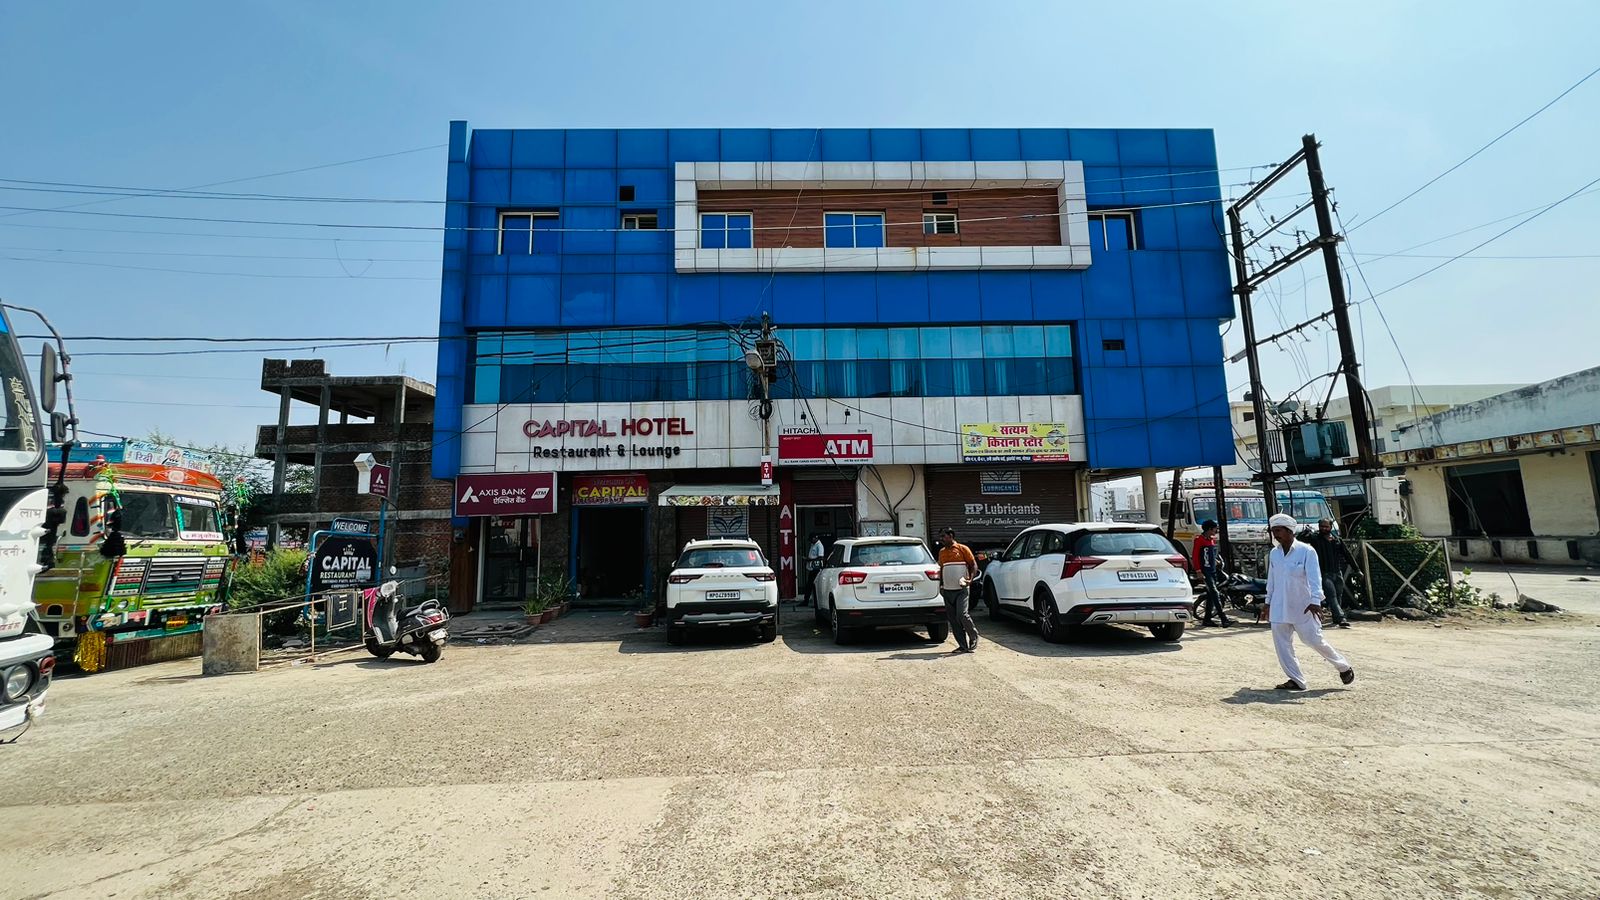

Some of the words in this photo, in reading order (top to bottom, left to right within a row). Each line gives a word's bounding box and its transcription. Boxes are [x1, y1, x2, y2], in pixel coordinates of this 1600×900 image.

[522, 419, 617, 438] CAPITAL
[621, 417, 694, 436] HOTEL
[1000, 425, 1029, 435] सत्यम
[824, 439, 869, 455] ATM
[987, 436, 1020, 447] किराना
[1022, 435, 1044, 447] स्टोर
[533, 446, 611, 458] Restaurant
[617, 444, 626, 457] &
[632, 444, 681, 458] Lounge
[502, 488, 526, 496] BANK
[578, 486, 646, 498] CAPITAL
[985, 503, 1040, 515] Lubricants
[334, 522, 367, 532] WELCOME
[966, 518, 992, 526] Zindagi
[780, 504, 793, 571] ATM
[322, 556, 372, 570] CAPITAL
